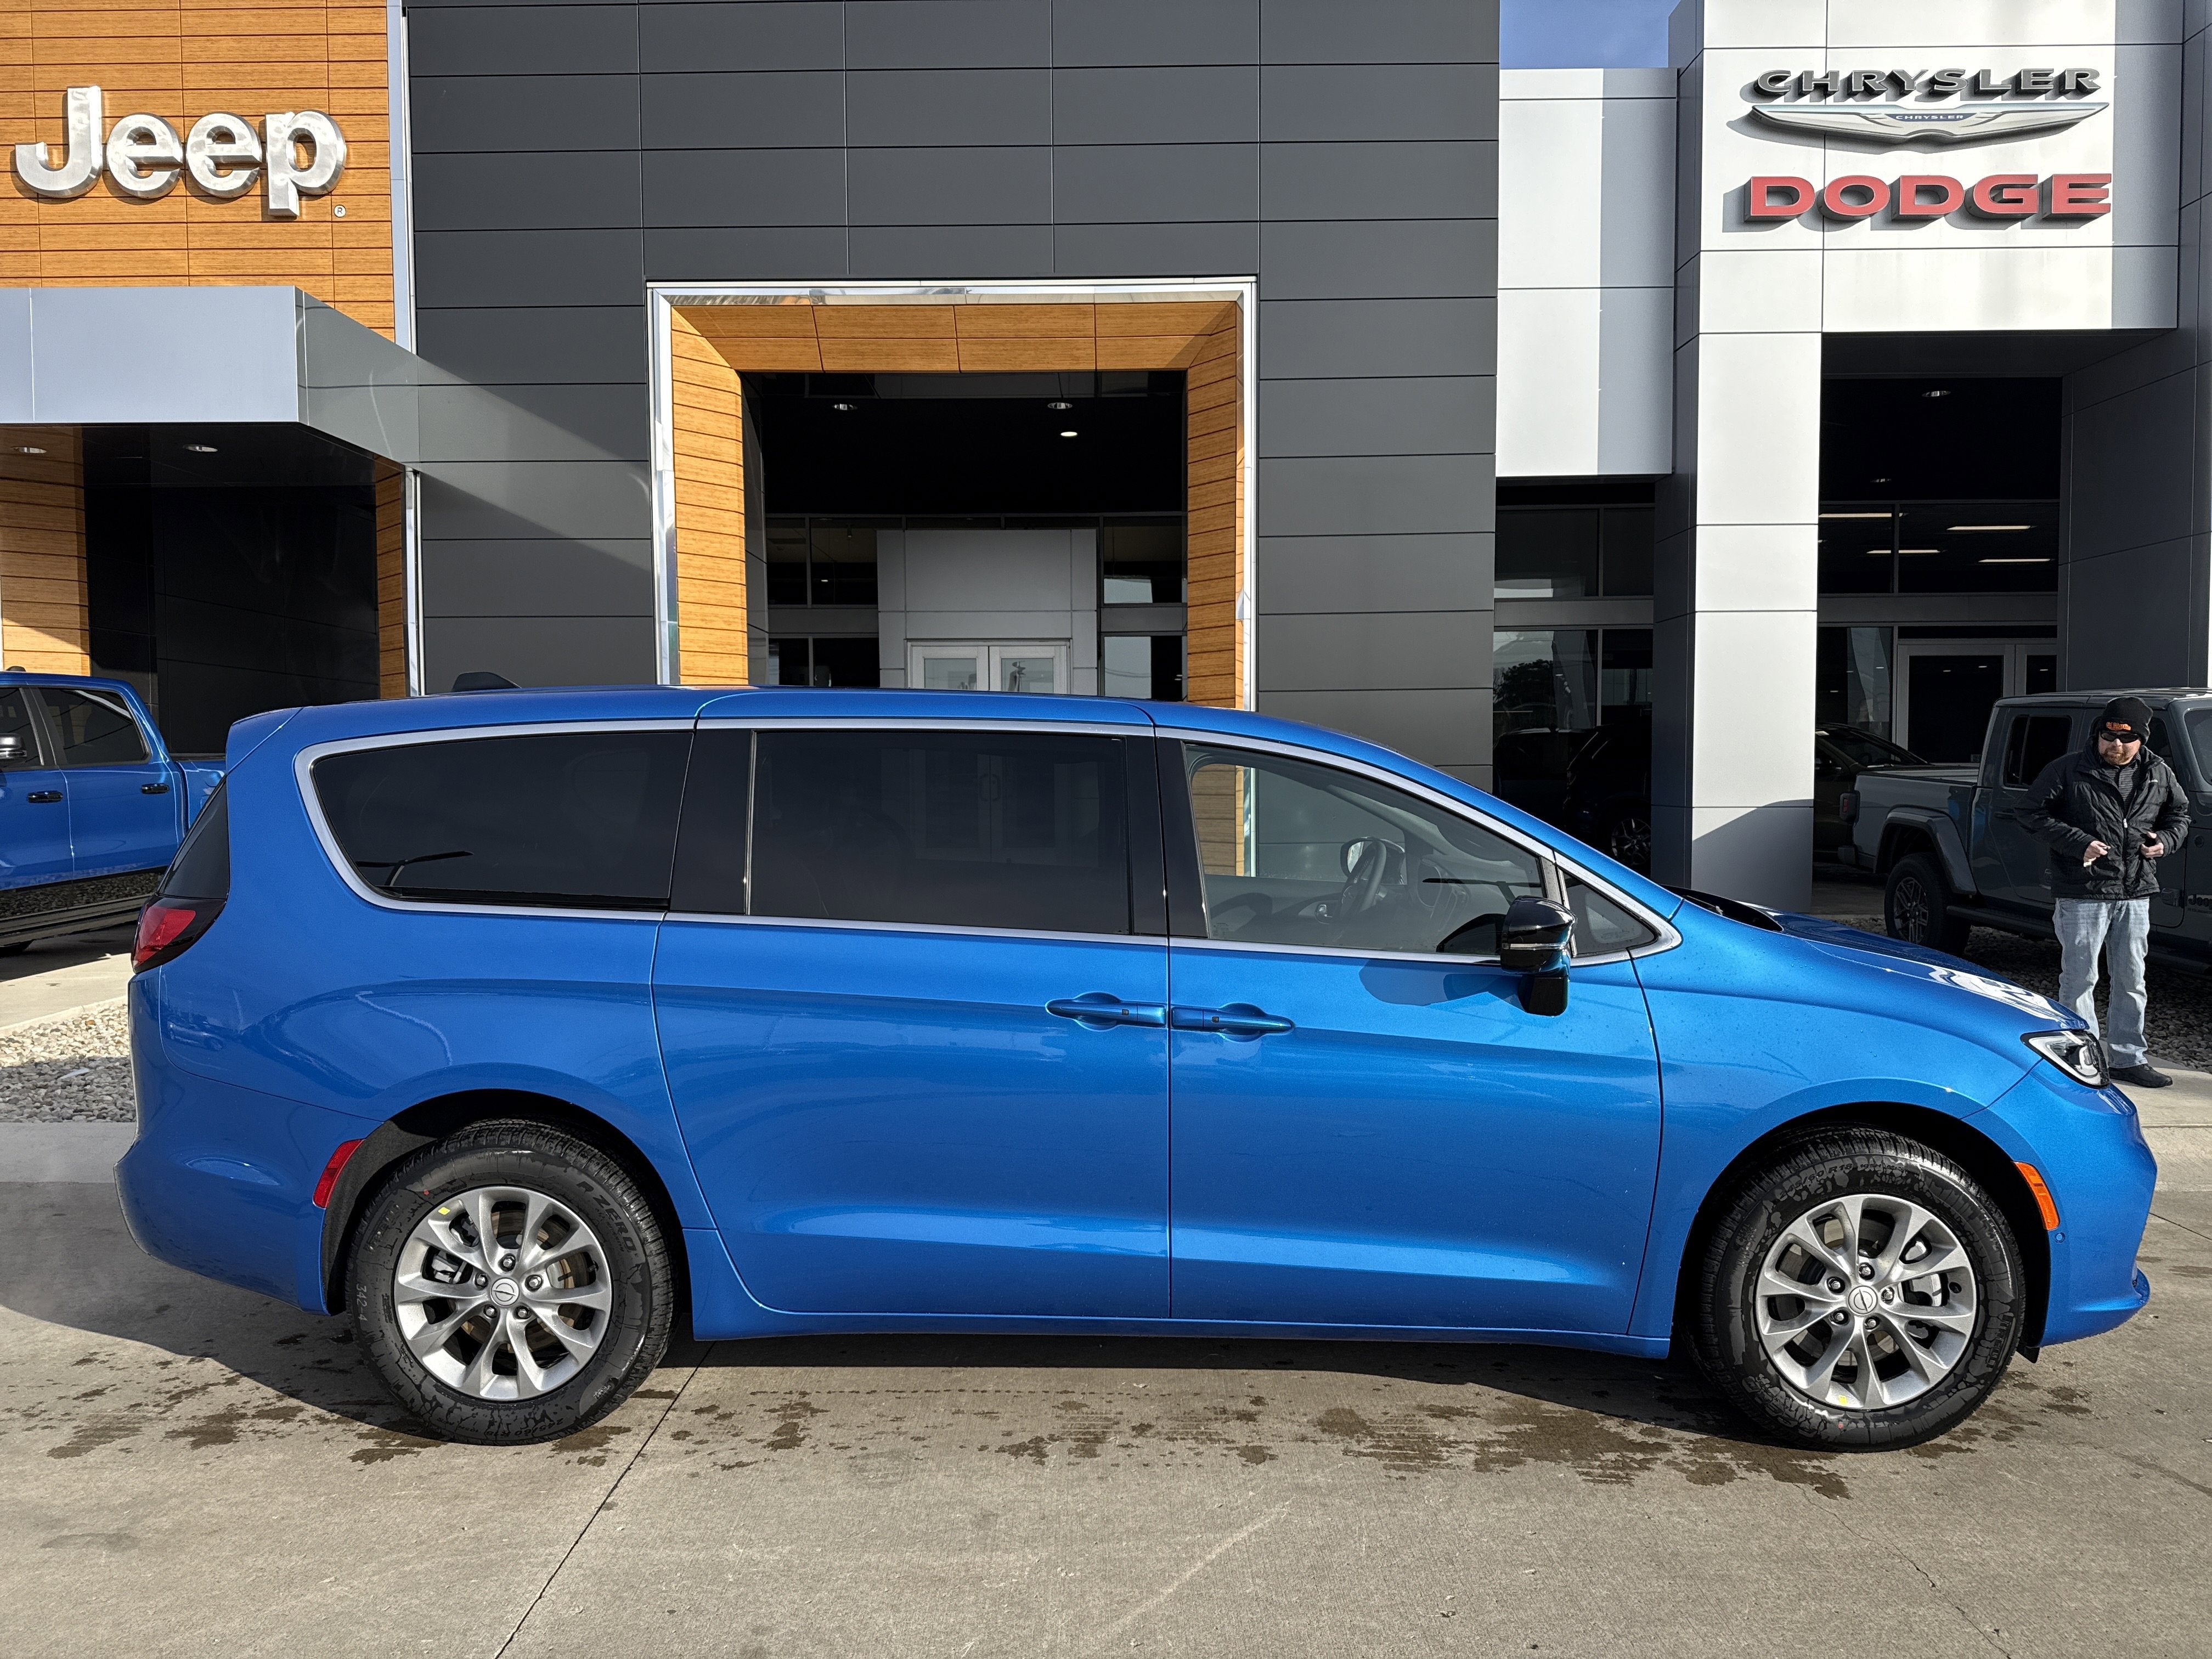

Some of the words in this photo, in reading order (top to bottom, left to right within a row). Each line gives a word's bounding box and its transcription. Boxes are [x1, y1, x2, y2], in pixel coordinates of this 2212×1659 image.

[1756, 68, 2102, 96] CHRYSLER
[14, 86, 347, 217] Jeep
[1747, 173, 2112, 218] DODGE
[357, 1283, 369, 1322] 342-4
